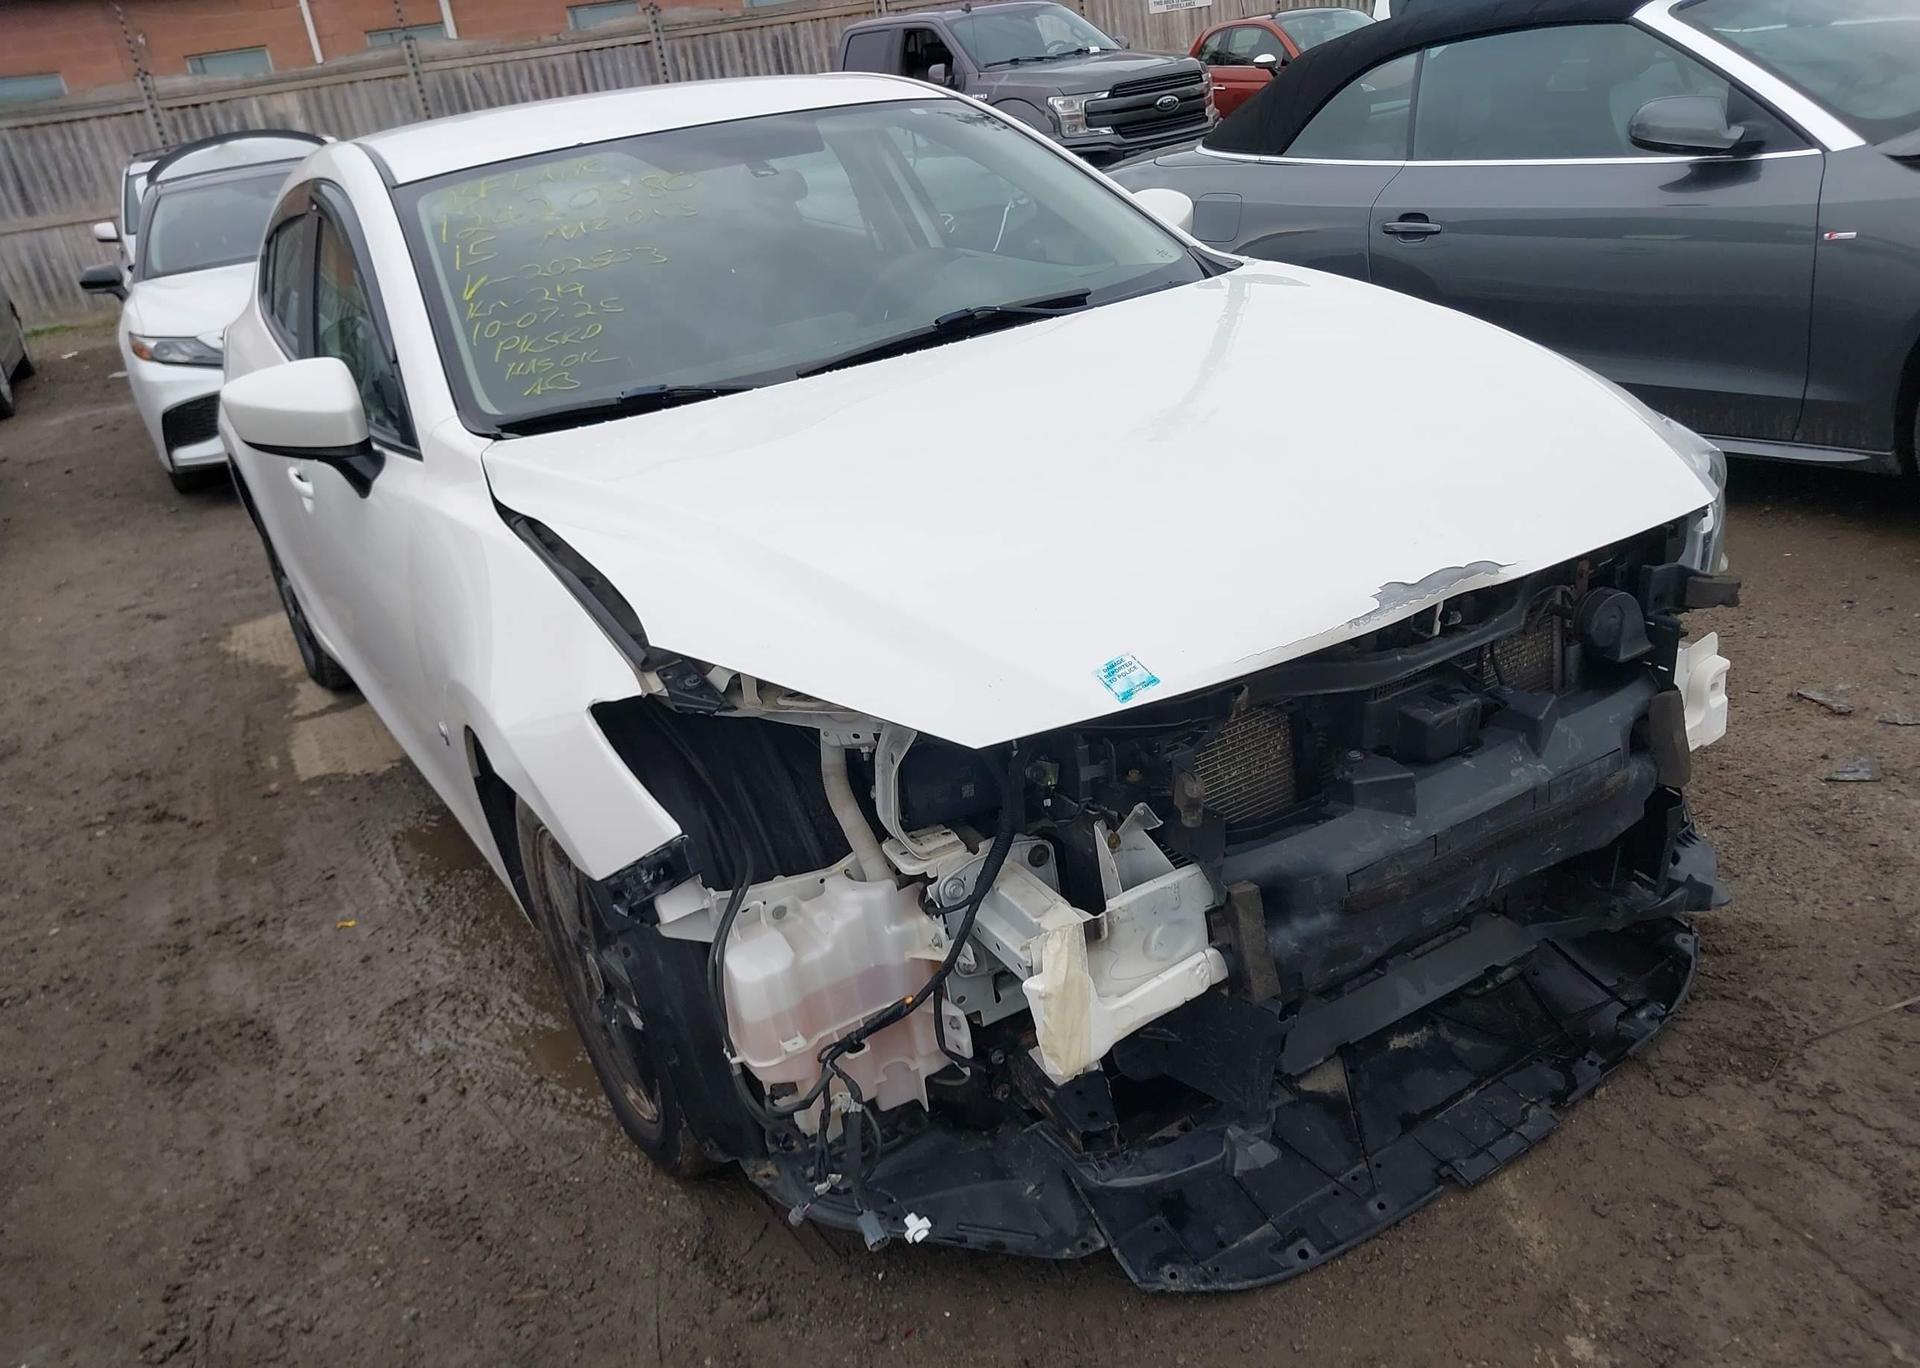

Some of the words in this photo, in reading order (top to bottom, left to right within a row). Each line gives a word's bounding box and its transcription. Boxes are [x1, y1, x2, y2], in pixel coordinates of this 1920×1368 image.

[1102, 658, 1126, 673] DAMAGE
[1103, 660, 1133, 680] REPORTED
[1117, 665, 1138, 679] POLICE
